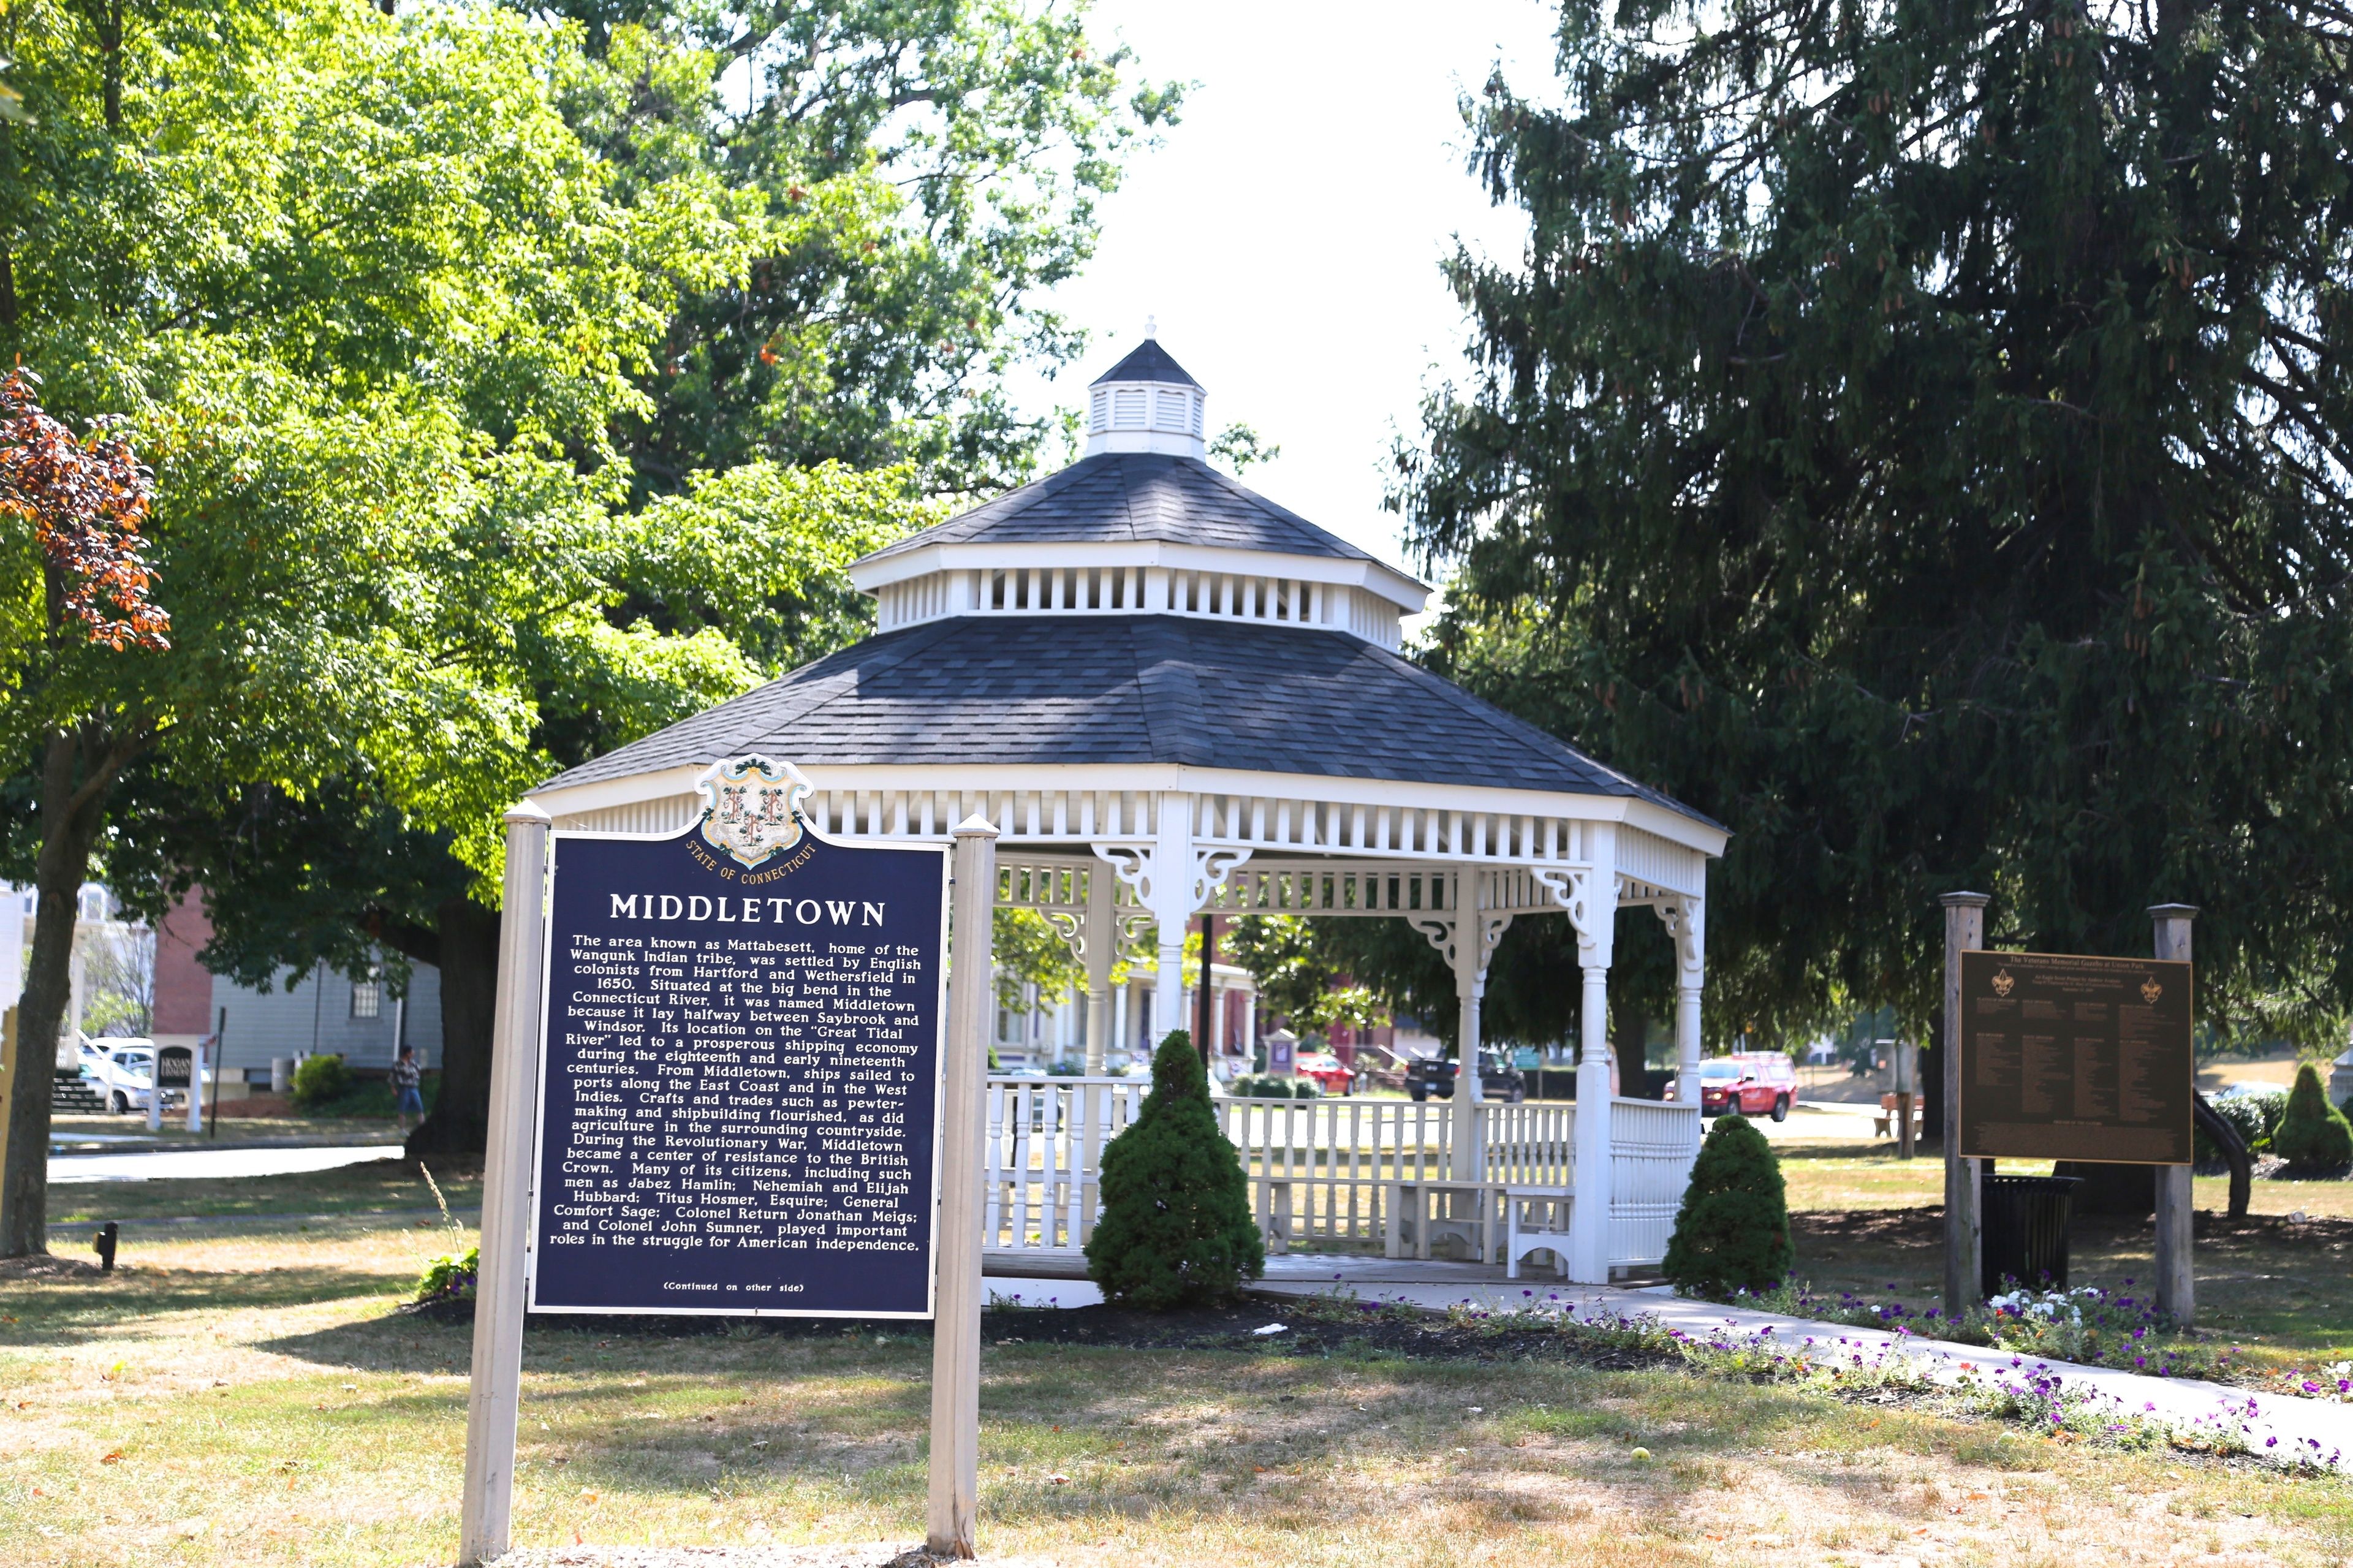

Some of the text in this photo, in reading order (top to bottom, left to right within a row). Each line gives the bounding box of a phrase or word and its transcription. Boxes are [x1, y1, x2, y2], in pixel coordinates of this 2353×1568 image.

[686, 840, 816, 885] STATE OF CONNECTICUT
[610, 893, 885, 927] MIDDLETOWN
[572, 934, 919, 956] The area known as Mattabesett, home of the
[570, 949, 921, 972] Wangunk Indian tribe, was settled by English
[574, 963, 915, 984] colonists from Hartford and Wethersfield in
[597, 977, 892, 998] 1650. Situated at the big bend in the
[572, 991, 915, 1012] Connecticut River, it was named Middletown
[567, 1005, 919, 1026] because it lay halfway between Saybrook and
[583, 1020, 645, 1032] Windsor.
[661, 1021, 679, 1033] Its
[686, 1022, 746, 1035] location
[755, 1026, 772, 1036] on
[779, 1025, 802, 1037] the
[865, 1027, 903, 1039] Tidal
[619, 1035, 642, 1047] led
[650, 1036, 665, 1047] to
[675, 1039, 684, 1048] a
[693, 1039, 775, 1051] prosperous
[785, 1039, 845, 1054] shipping
[855, 1043, 919, 1056] economy
[577, 1048, 905, 1067] during the eighteenth and early nineteenth
[567, 1062, 915, 1081] centuries. From Middletown, ships sailed to
[574, 1077, 907, 1096] ports along the East Coast and in the West
[575, 1090, 904, 1111] Indies. Crafts and trades such as pewter-
[574, 1105, 904, 1124] making and shipbuilding flourished, as did
[573, 1132, 903, 1152] During the Revolutionary War, Middletown
[566, 1147, 909, 1166] became a center of resistance to the British
[564, 1177, 909, 1196] men as Jabez Hamlin; Nehemiah and Elijah
[574, 1190, 898, 1208] Hubbard; Titus Hosmer, Esquire; General
[553, 1204, 917, 1225] Comfort Sage; Colonel Return Jonathan Meigs;
[563, 1219, 907, 1238] and Colonel John Sumner, played important
[550, 1233, 919, 1252] roles in the struggle for American independence.
[663, 1281, 718, 1290] (Continued
[745, 1283, 772, 1292] other
[779, 1284, 804, 1292] side)
